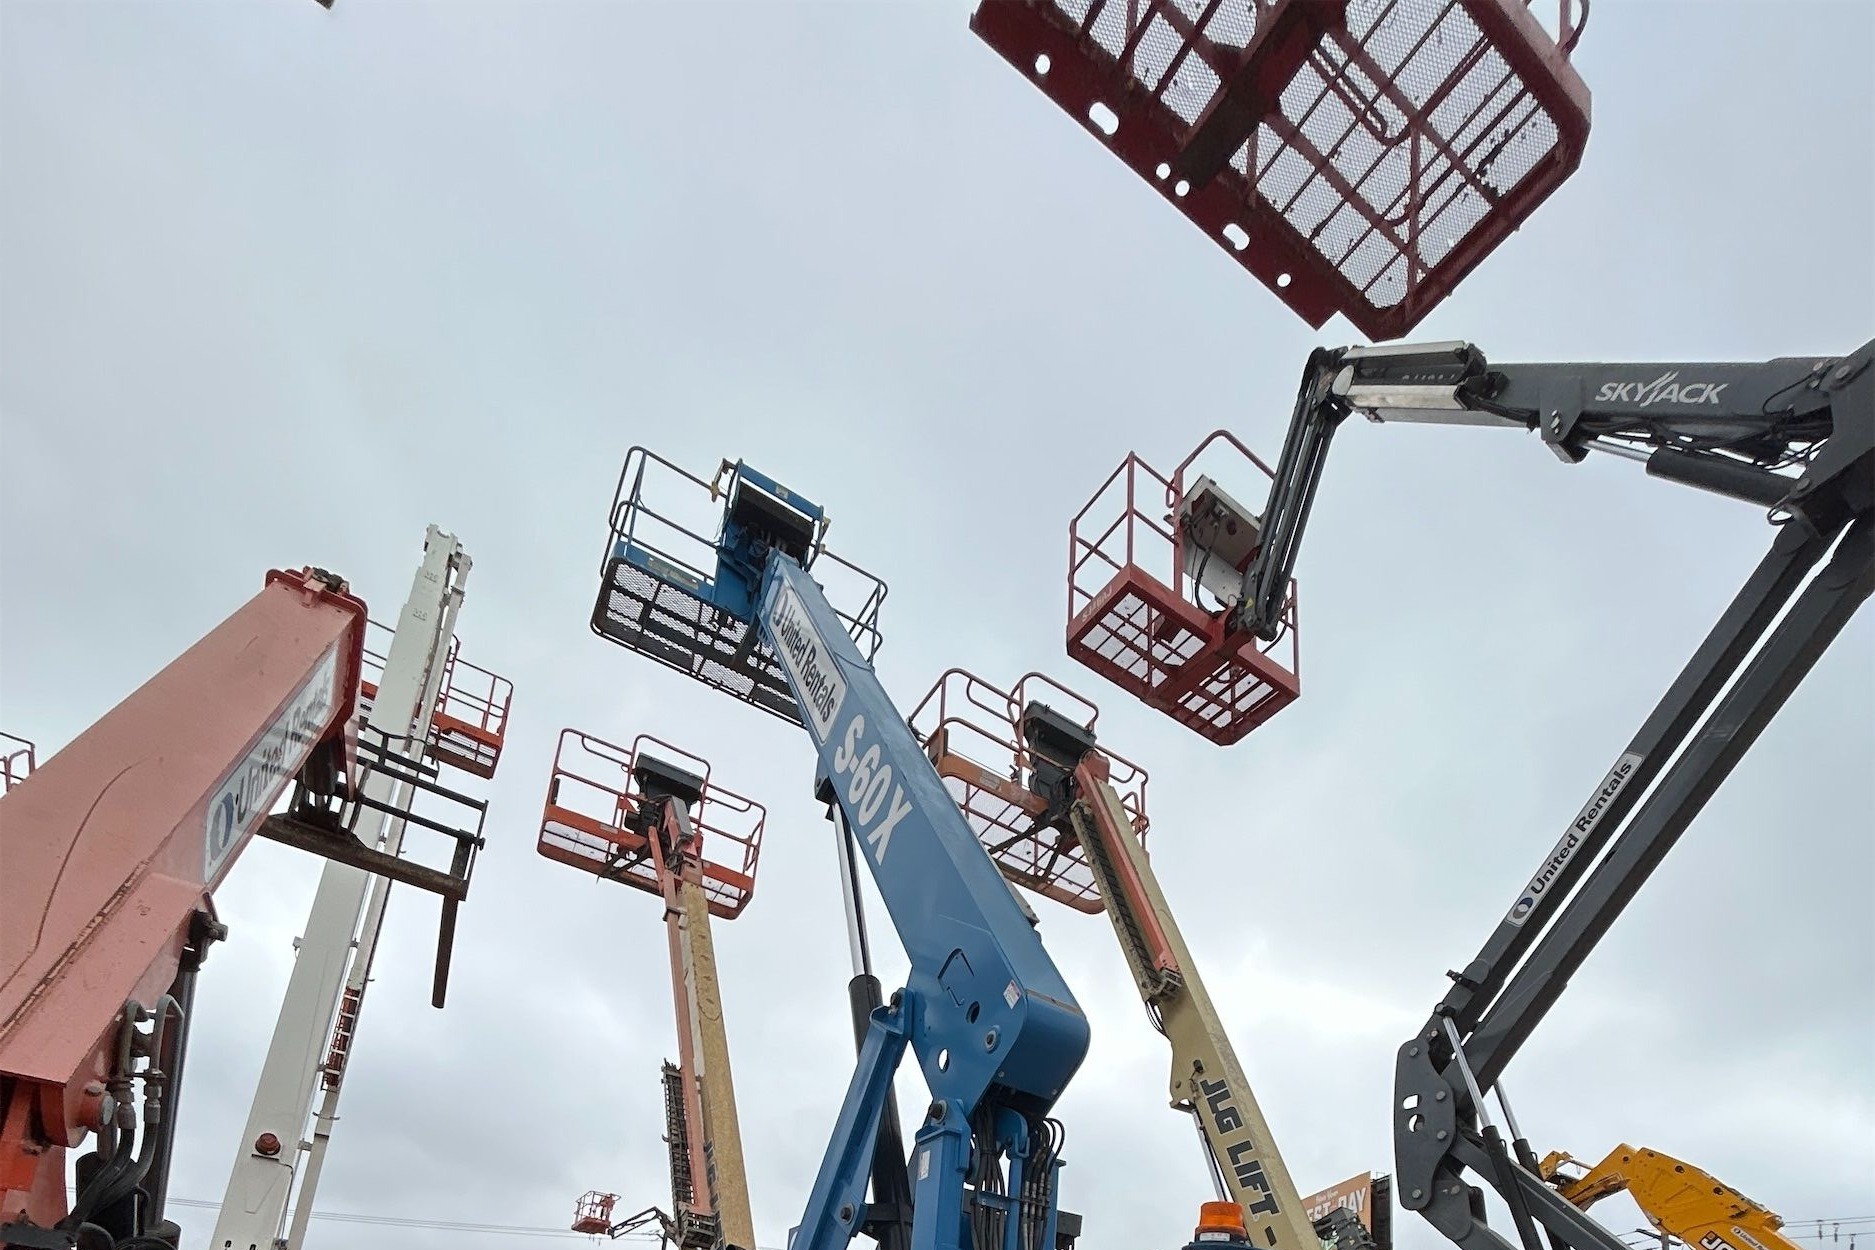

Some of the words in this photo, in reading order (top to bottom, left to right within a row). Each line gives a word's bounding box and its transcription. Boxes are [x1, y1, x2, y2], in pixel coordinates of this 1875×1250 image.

[1595, 370, 1730, 408] SKYJACK
[781, 605, 812, 666] United
[800, 644, 837, 724] Rentals
[833, 713, 914, 867] S-60X
[1530, 833, 1580, 895] United
[1574, 761, 1633, 833] Rentals
[1199, 1078, 1244, 1136] JLG
[1226, 1139, 1281, 1216] LIFT
